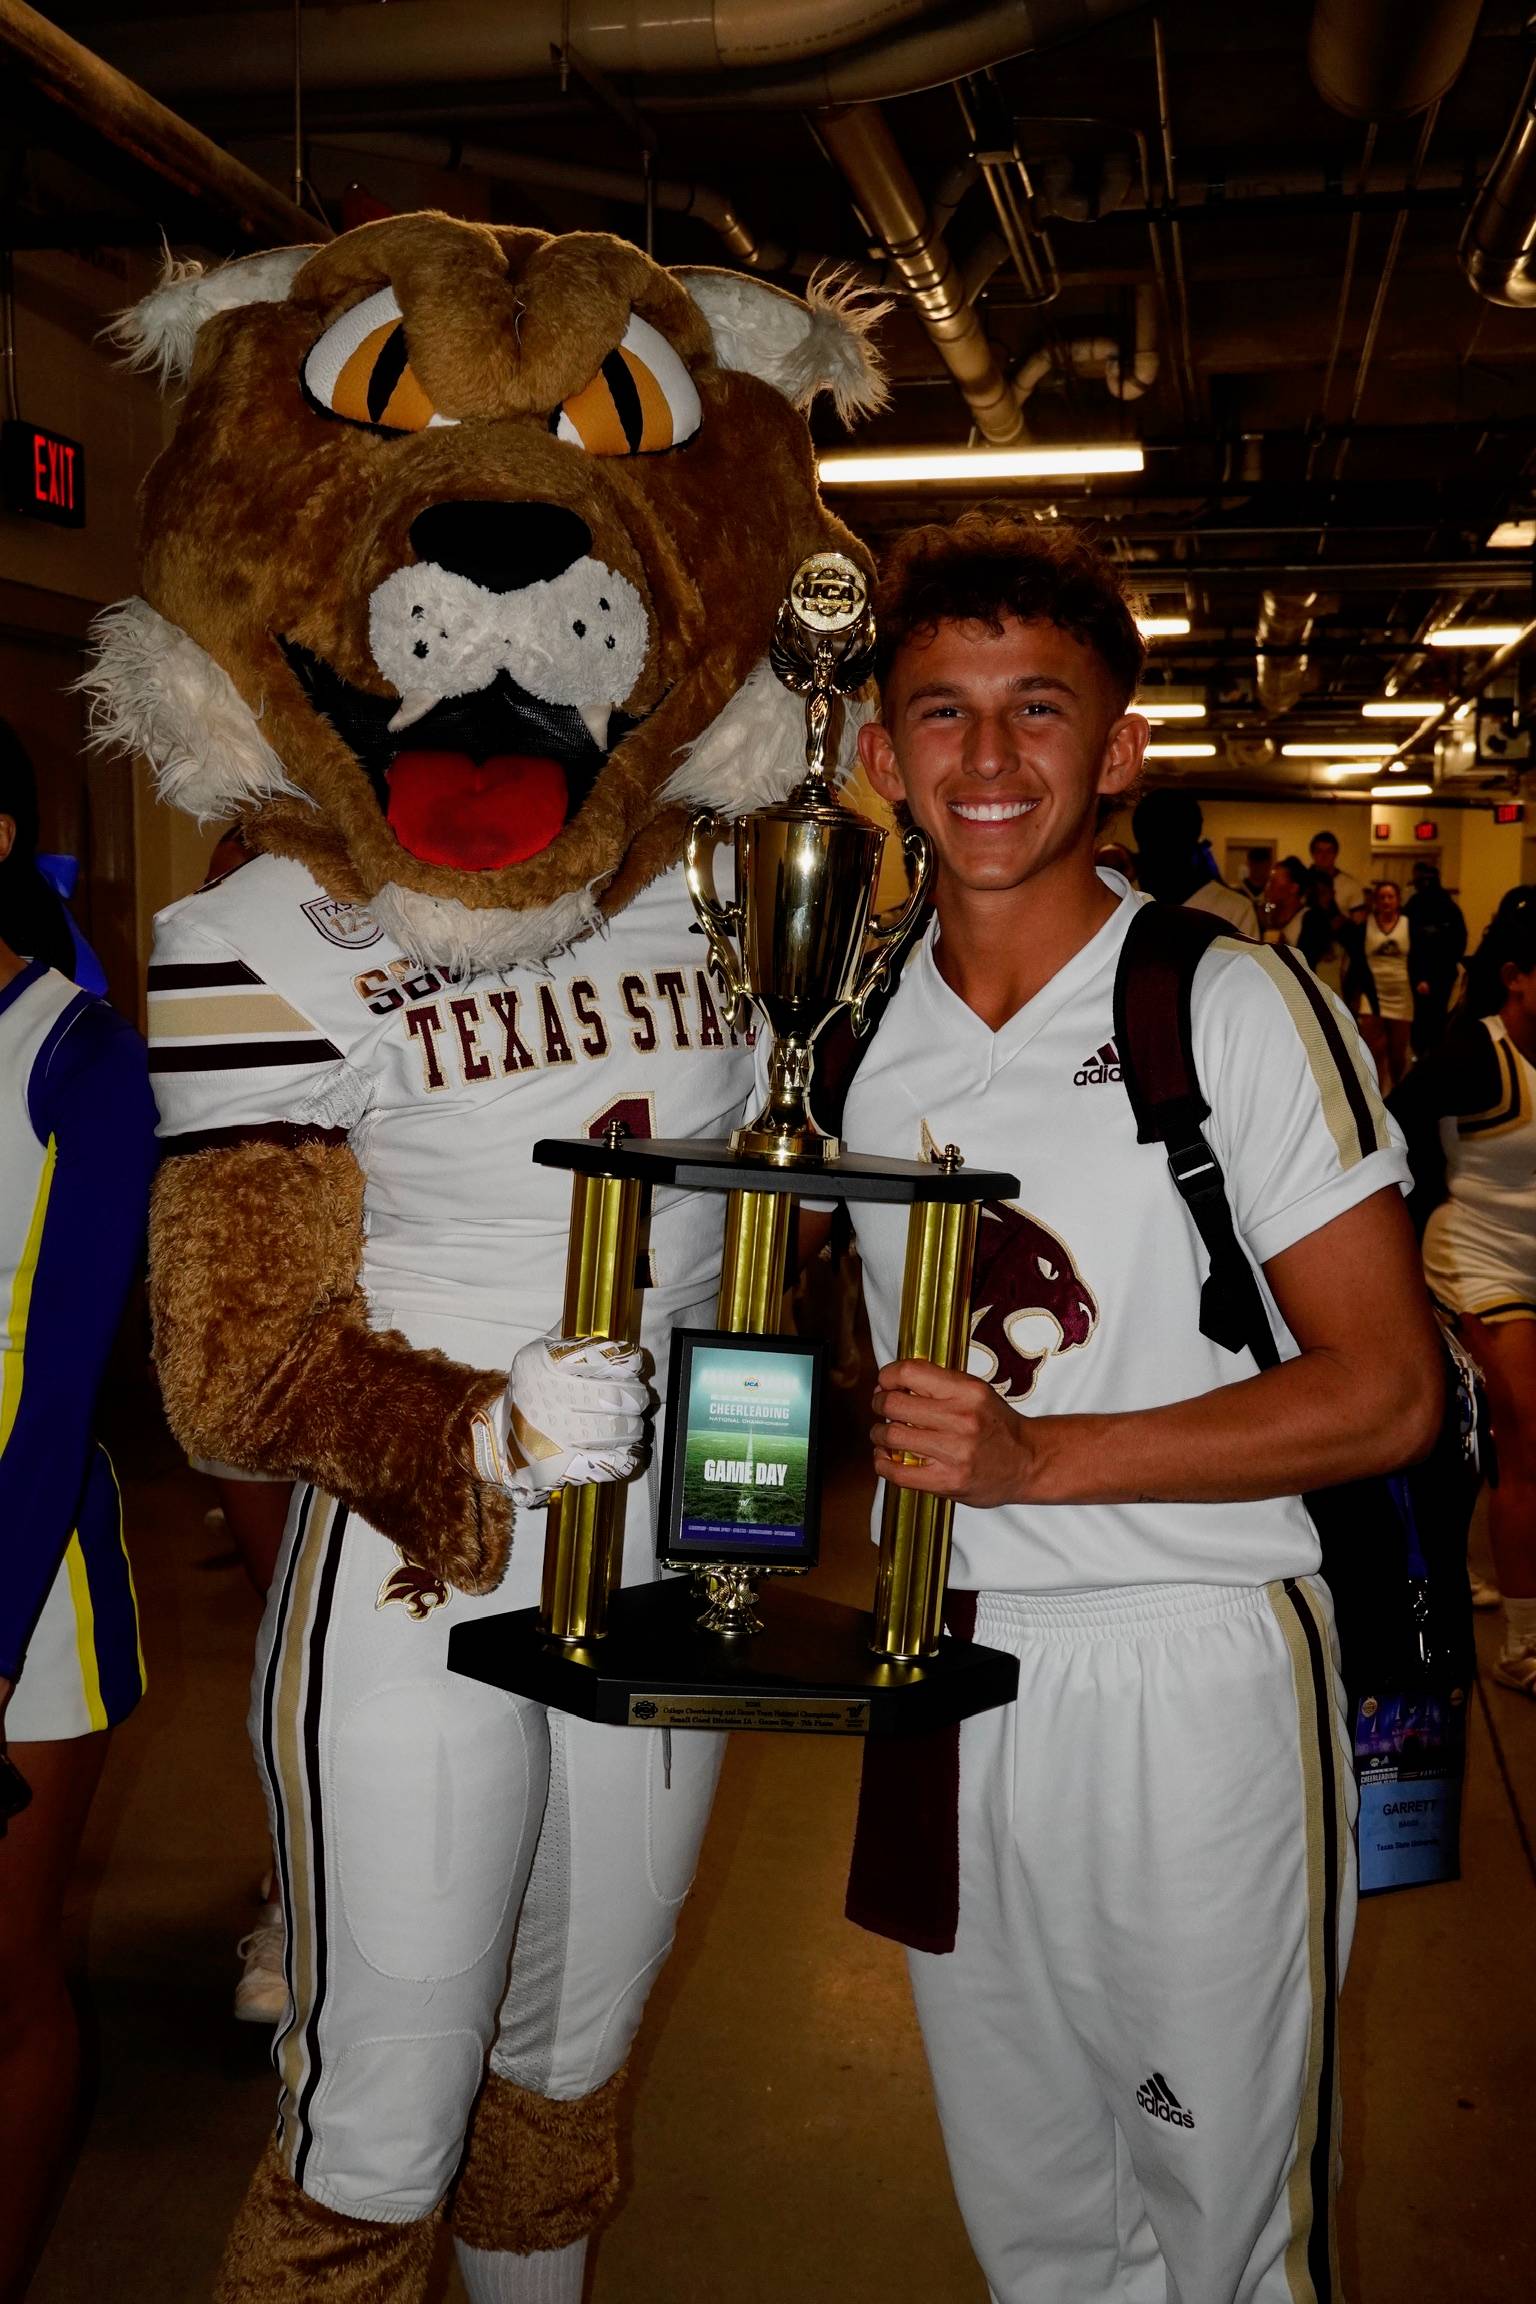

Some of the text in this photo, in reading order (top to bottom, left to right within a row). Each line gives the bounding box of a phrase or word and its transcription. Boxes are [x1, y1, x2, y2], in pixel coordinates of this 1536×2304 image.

[34, 434, 75, 510] EXIT
[803, 581, 856, 602] UCA
[404, 967, 757, 1093] TEXAS STA
[709, 1402, 790, 1419] CHEERLEADING
[709, 1416, 740, 1424] NATIONAL
[704, 1459, 788, 1487] GAME DAY
[1383, 1800, 1437, 1816] GARRETT
[1376, 1843, 1394, 1852] Texas
[1136, 2089, 1195, 2129] adidas
